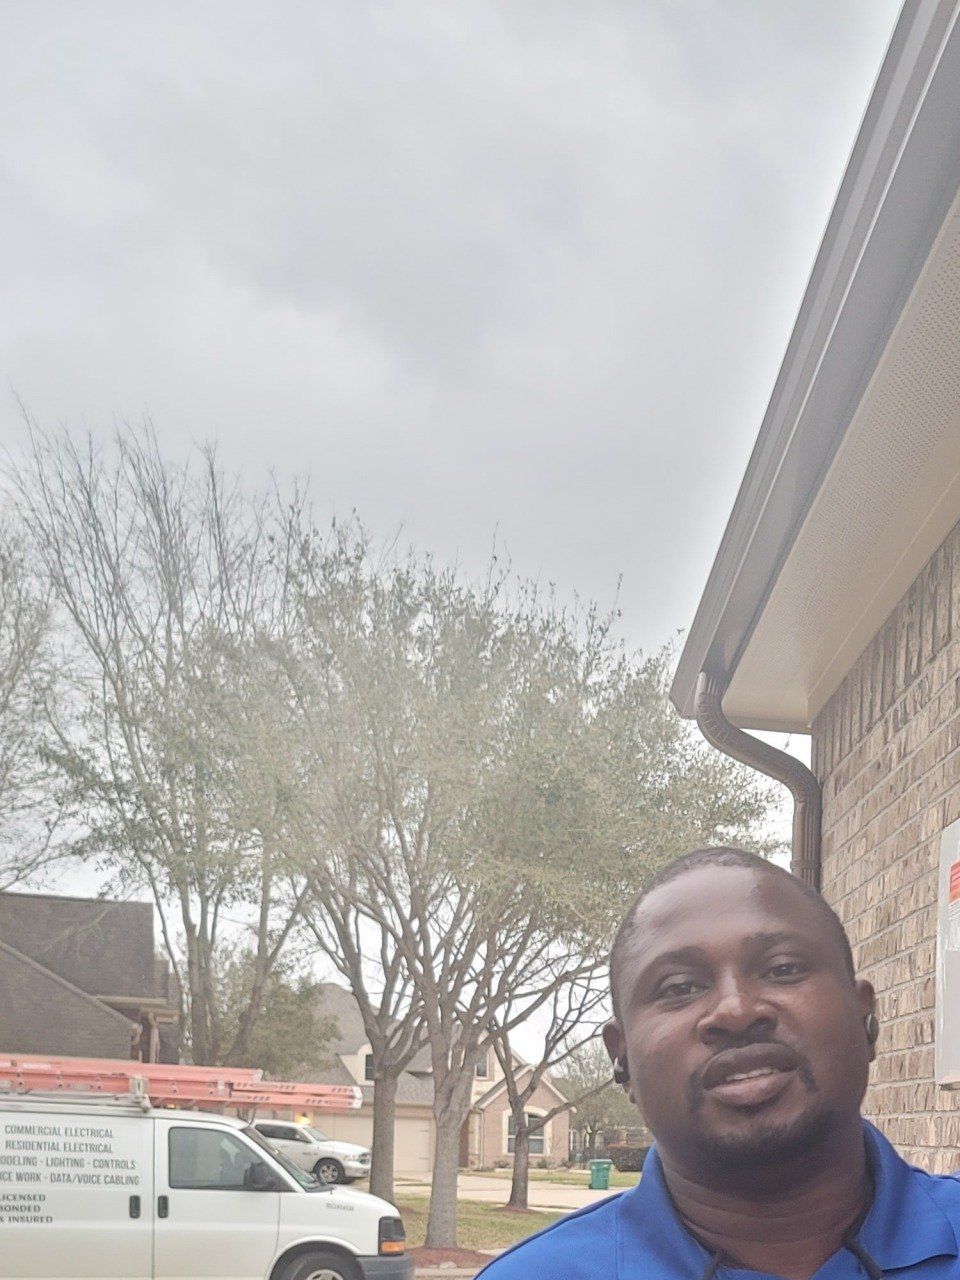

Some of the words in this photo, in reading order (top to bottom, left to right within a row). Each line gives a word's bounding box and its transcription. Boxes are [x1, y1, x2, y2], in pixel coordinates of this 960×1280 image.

[5, 1125, 61, 1136] COMMERCIAL
[65, 1127, 114, 1138] ELECTRICAL
[5, 1140, 60, 1151] RESIDENTIAL
[63, 1142, 113, 1153] ELECTRICAL
[46, 1157, 85, 1168] LIGHTING
[93, 1159, 136, 1169] CONTROLS
[16, 1172, 41, 1183] WORK
[50, 1173, 101, 1184] DATA/VOICE
[104, 1175, 140, 1186] CABLING
